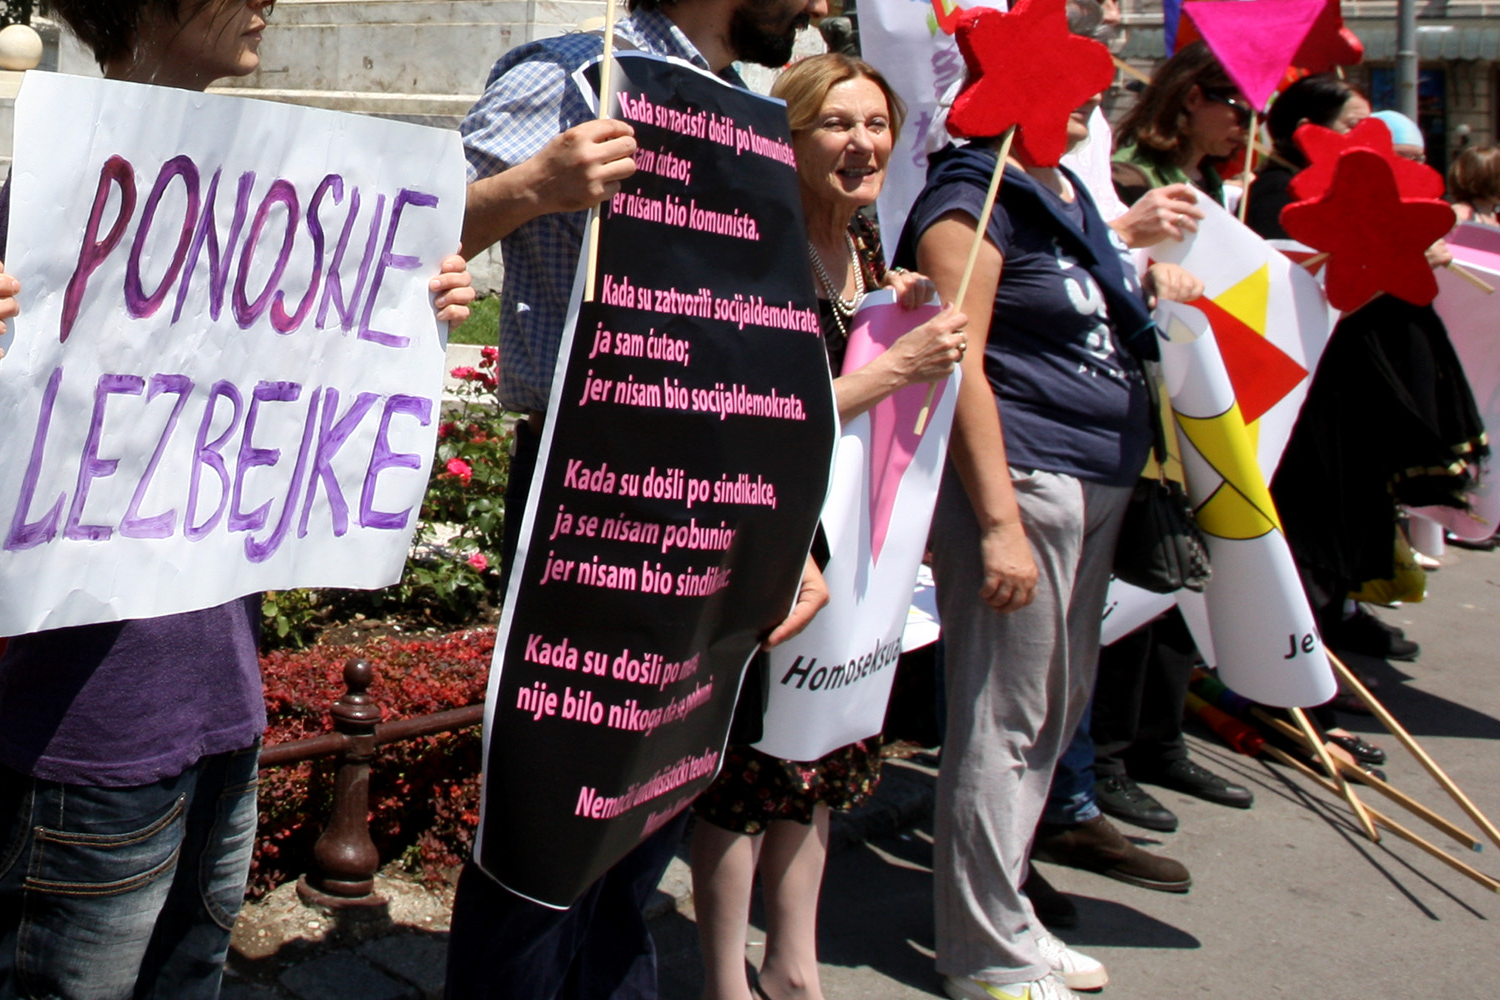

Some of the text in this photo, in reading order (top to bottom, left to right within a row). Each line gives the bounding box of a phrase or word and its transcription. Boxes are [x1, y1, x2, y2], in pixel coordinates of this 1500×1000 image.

[617, 91, 653, 126] Kada
[655, 105, 668, 128] su
[708, 113, 734, 146] došli
[736, 128, 750, 155] po
[627, 188, 662, 223] nisam
[665, 194, 687, 227] bio
[689, 199, 760, 241] komunista.
[60, 154, 439, 348] PONOSNE
[602, 274, 820, 338] Kada su zatvorili socijaldemokrate,
[589, 322, 690, 367] ja sam ćutao;
[579, 369, 806, 421] jer nisam bio socijaldemokrata.
[3, 366, 432, 563] LEZBEJKE
[563, 459, 776, 510] Kada su došli po sindikalce,
[550, 504, 573, 541] ja
[575, 515, 598, 537] se
[601, 512, 660, 544] nisam
[540, 550, 574, 586] jer
[576, 555, 637, 591] nisam
[641, 560, 672, 595] bio
[524, 633, 579, 671] Kada
[582, 649, 608, 676] su
[612, 648, 664, 685] došli
[660, 662, 680, 691] po
[516, 681, 558, 721] nije
[561, 687, 604, 725] bilo
[607, 699, 663, 737] nikoga
